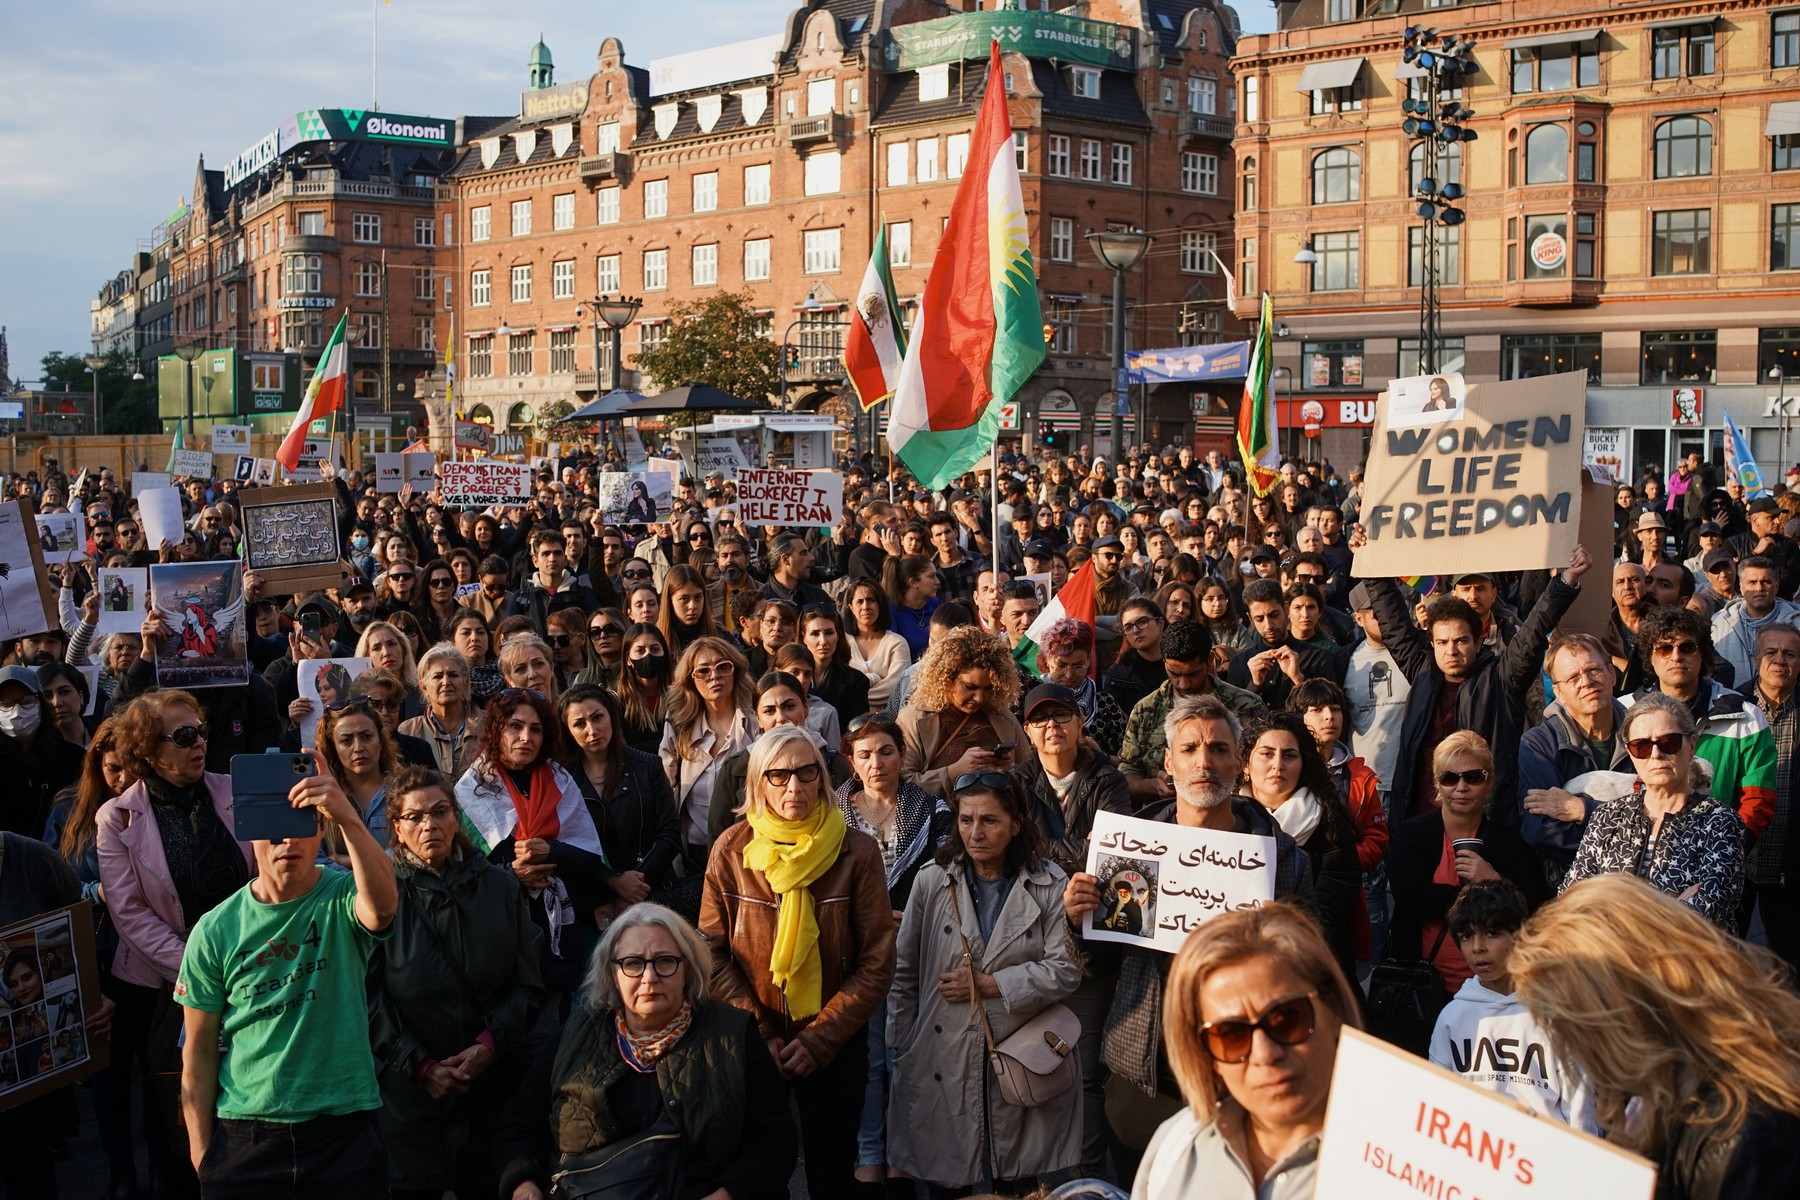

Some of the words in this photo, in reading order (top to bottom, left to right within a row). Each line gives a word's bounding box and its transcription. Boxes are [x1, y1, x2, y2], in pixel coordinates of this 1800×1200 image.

[914, 30, 977, 51] STARBUCKS
[1034, 29, 1101, 48] STARBUCKS
[527, 94, 568, 117] Netto
[366, 117, 446, 140] Økonomi
[223, 127, 280, 192] POLITIKEN
[1537, 247, 1563, 260] KING
[256, 399, 280, 407] GSV
[488, 434, 525, 456] JINA
[1387, 414, 1571, 457] WOMEN
[1589, 435, 1619, 443] BUCKET
[175, 460, 210, 468] COMPULSORY
[182, 452, 205, 460] STOP
[443, 463, 529, 477] DEMONSTRAN-
[738, 469, 813, 486] INTERNET
[1417, 453, 1522, 495] LIFE
[443, 475, 470, 485] TER
[474, 475, 521, 486] SKYDES
[443, 485, 459, 495] OG
[462, 484, 508, 496] DRÆBES
[444, 495, 470, 504] VÆR
[473, 495, 499, 504] VORES
[738, 485, 809, 504] BLOKERET
[814, 489, 827, 507] I
[740, 503, 779, 521] HELE
[784, 504, 832, 523] IRAN
[1369, 492, 1572, 541] FREEDOM
[253, 526, 277, 543] ایران
[235, 949, 254, 976] I
[301, 919, 322, 949] 4
[239, 957, 328, 1001] Iranian
[1449, 1036, 1549, 1080] NASA
[1486, 1074, 1507, 1082] SPACE
[1509, 1075, 1536, 1086] MISSION
[1363, 1141, 1462, 1200] ISLAMIC
